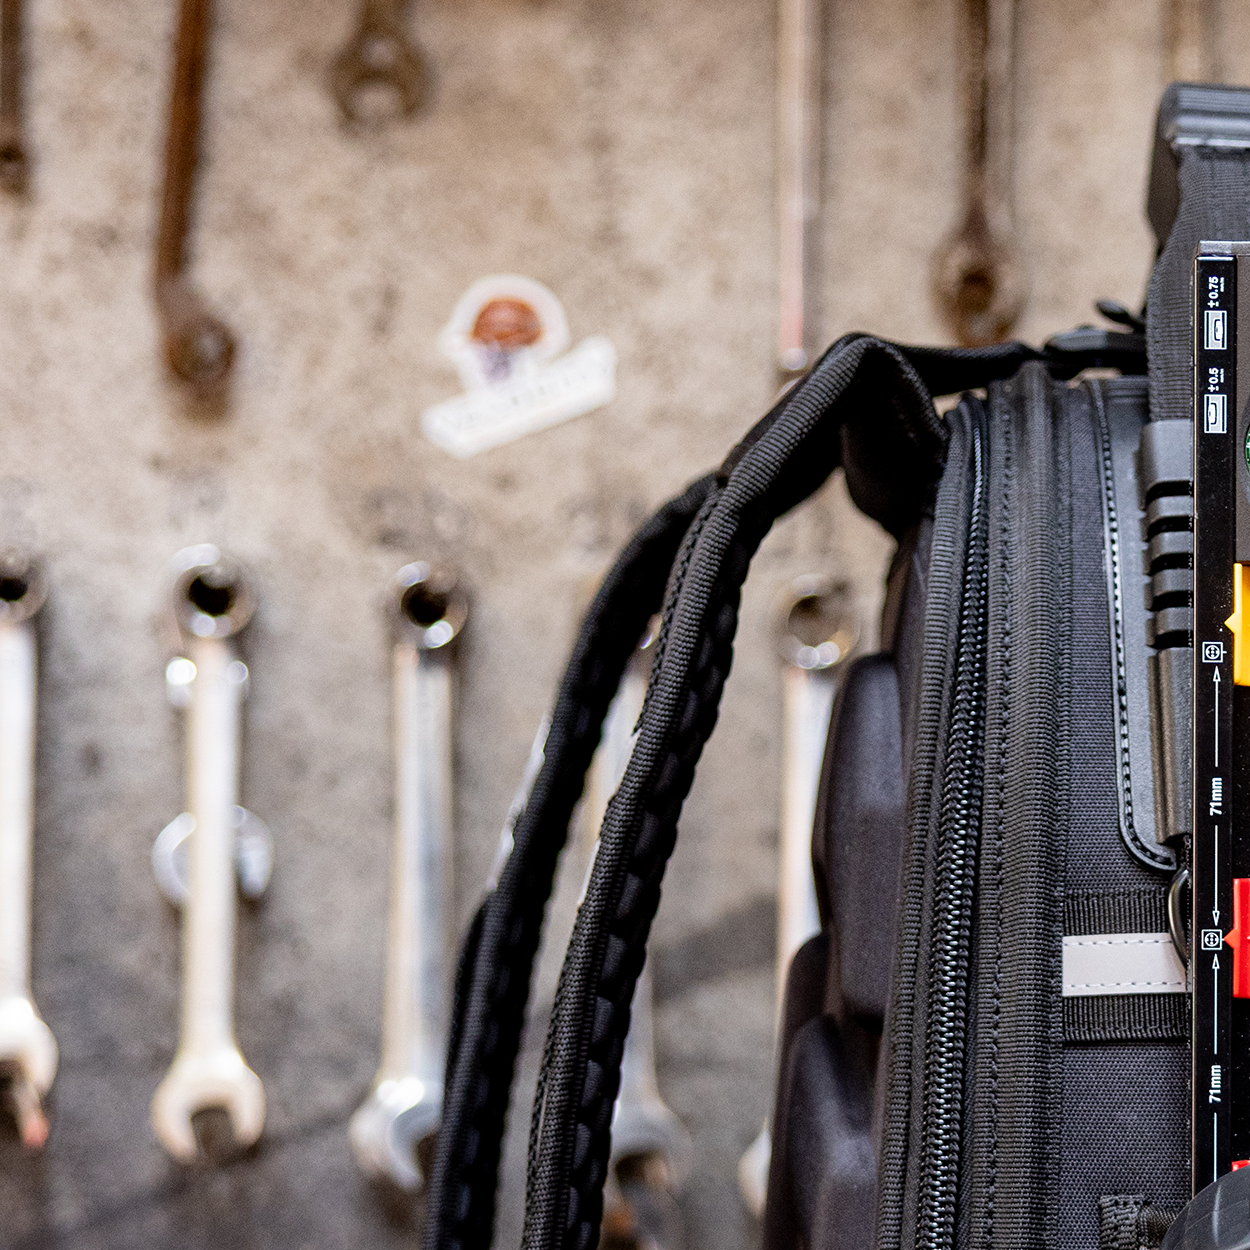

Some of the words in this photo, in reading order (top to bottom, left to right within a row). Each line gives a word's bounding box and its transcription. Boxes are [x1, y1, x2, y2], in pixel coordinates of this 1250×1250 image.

[1206, 276, 1220, 309] ±0.75
[1207, 367, 1220, 393] ±0.5
[1209, 777, 1223, 817] 71mm
[1208, 1064, 1222, 1104] 71mm
